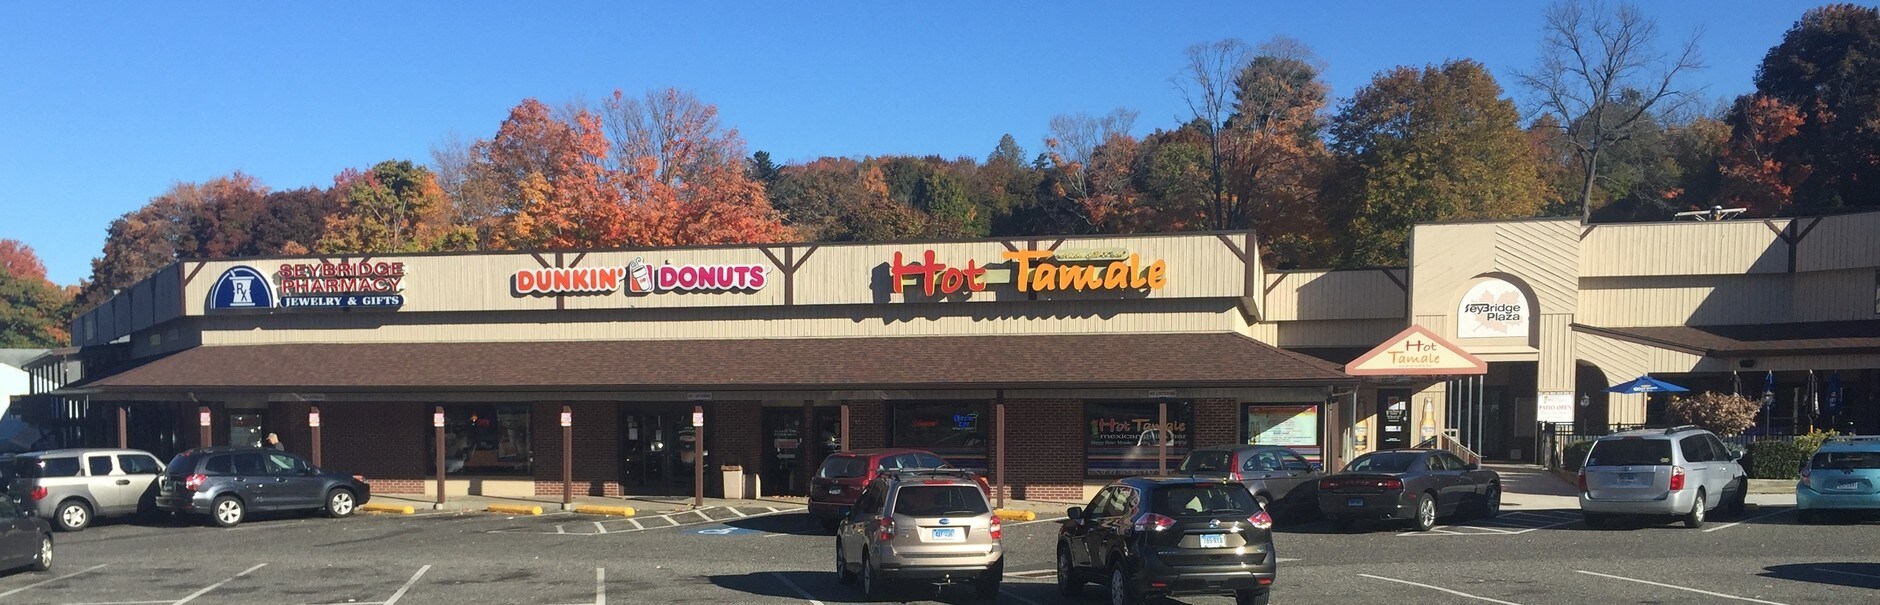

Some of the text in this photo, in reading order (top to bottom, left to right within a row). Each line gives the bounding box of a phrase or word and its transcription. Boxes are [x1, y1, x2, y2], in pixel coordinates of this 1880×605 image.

[279, 262, 405, 277] SEYBRIDGE
[891, 249, 1167, 296] Hot Tamale
[281, 277, 402, 293] PHARMACY
[517, 266, 765, 291] DUNKIN' DONUTS
[285, 296, 400, 307] JEWELRY & GIFTS
[1464, 303, 1521, 314] SeyBridge
[1487, 312, 1520, 321] Plaza
[1405, 340, 1437, 352] Hot
[1387, 350, 1440, 364] Tamale
[1099, 418, 1131, 432] Hot
